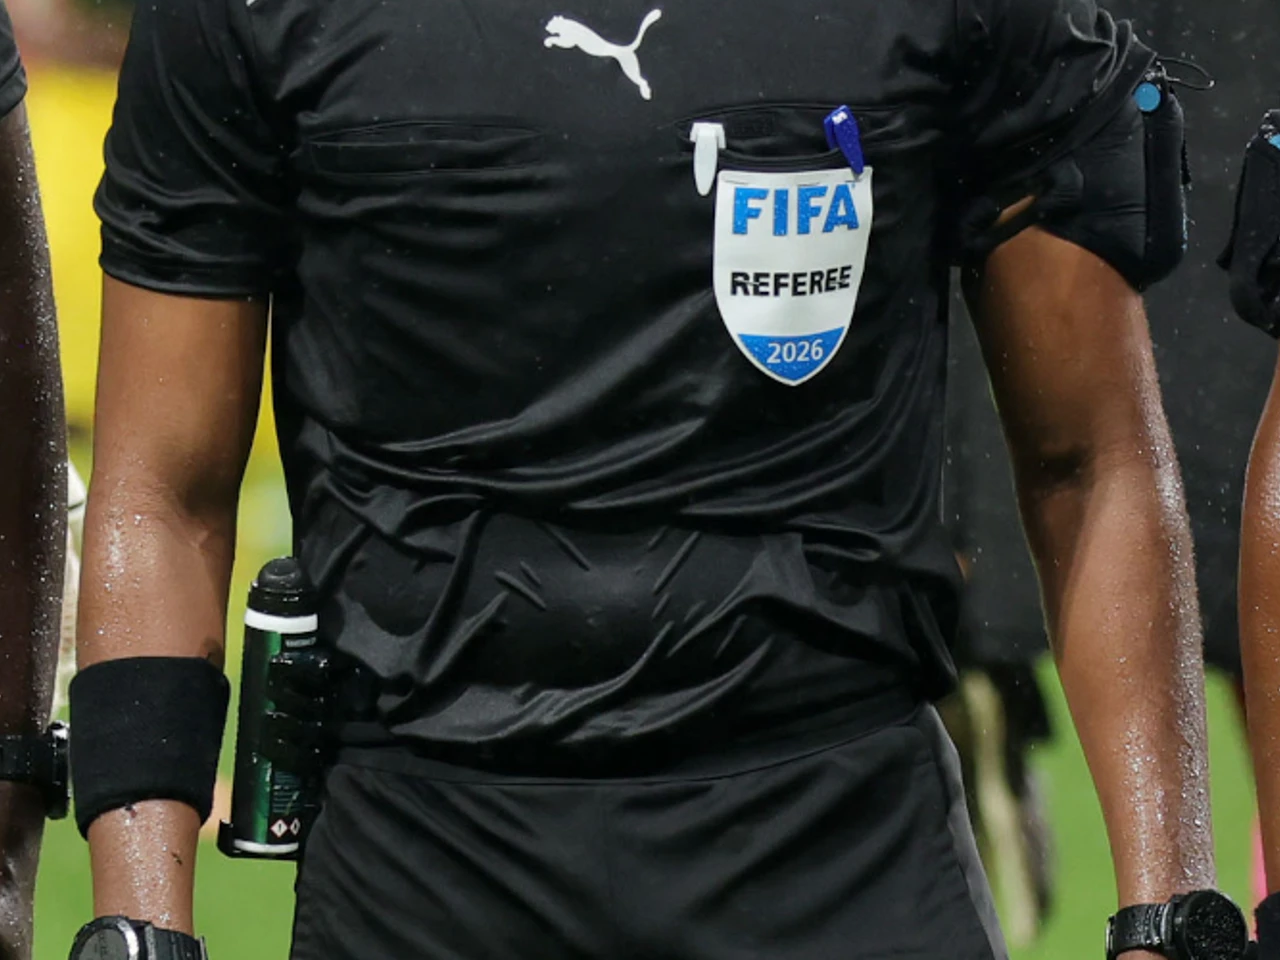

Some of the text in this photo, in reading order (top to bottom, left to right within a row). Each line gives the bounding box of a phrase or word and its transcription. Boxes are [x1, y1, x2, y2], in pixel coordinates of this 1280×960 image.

[732, 184, 859, 236] FIFA
[731, 265, 852, 297] REFEREE
[766, 339, 823, 363] 2026
